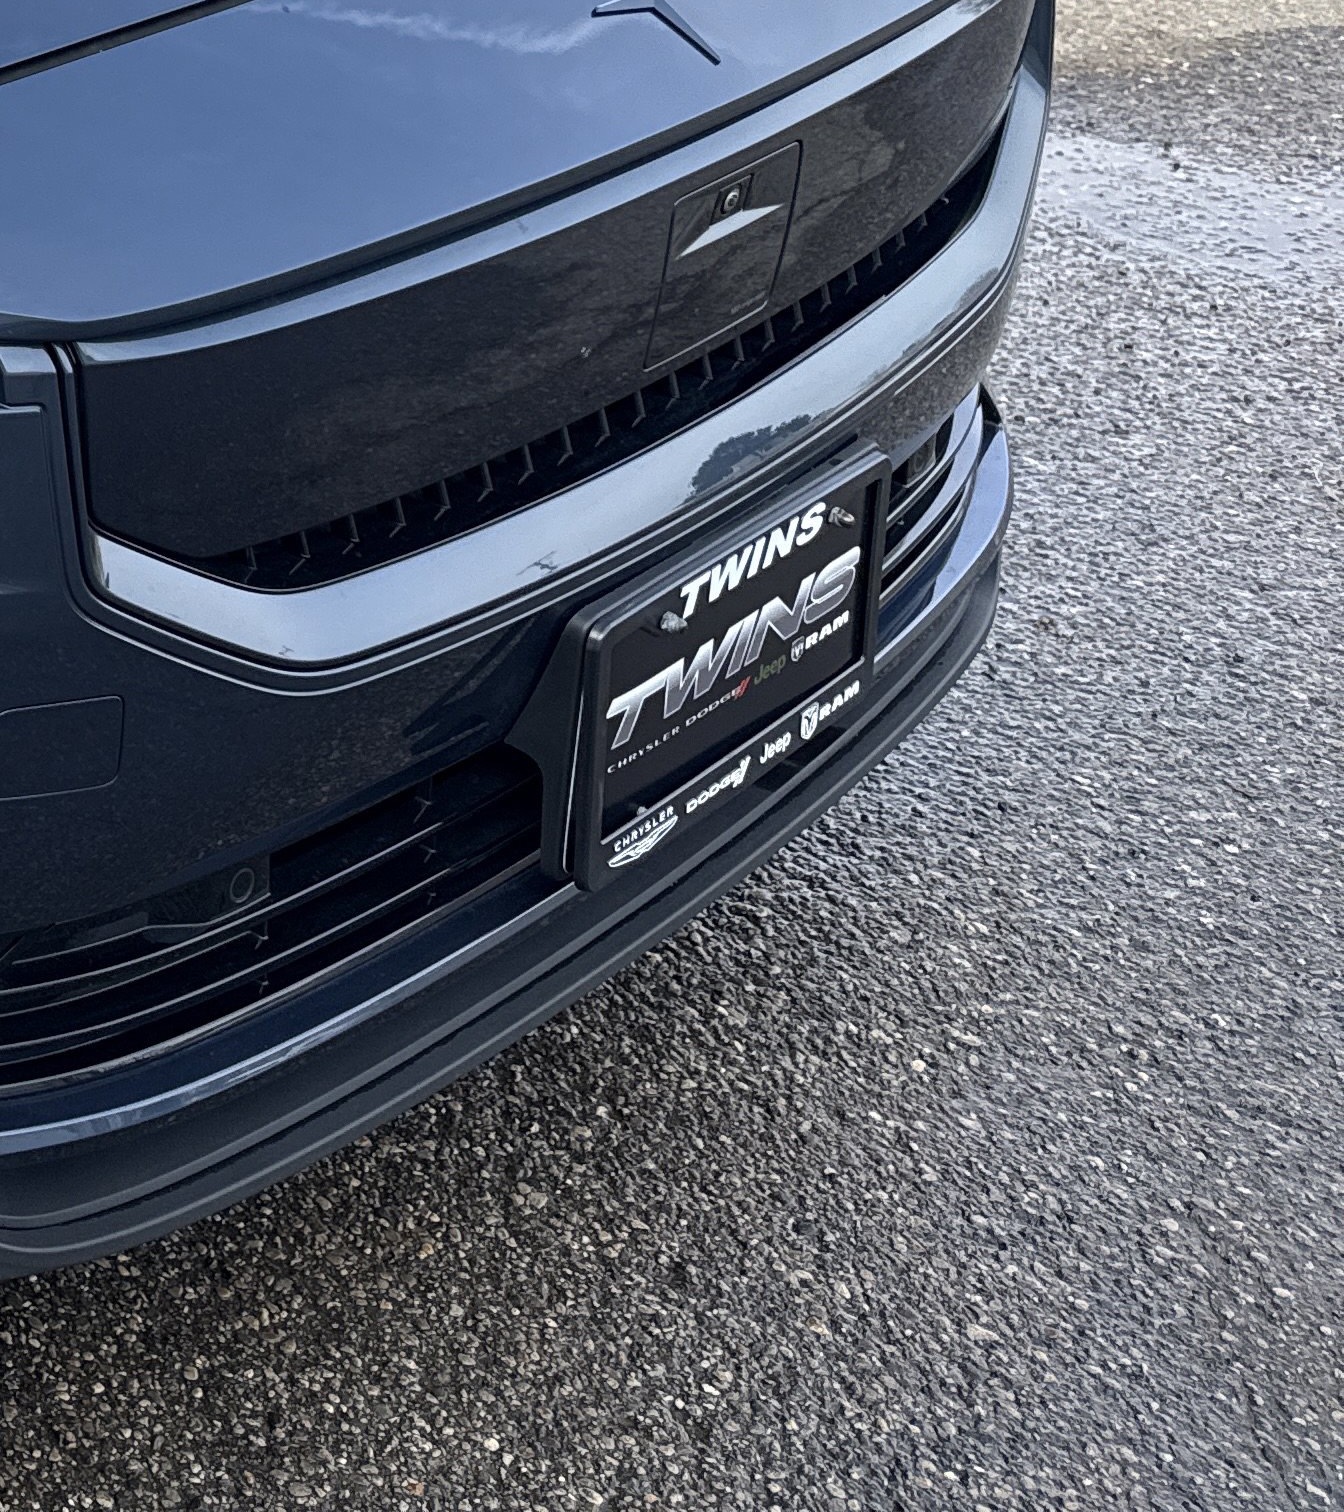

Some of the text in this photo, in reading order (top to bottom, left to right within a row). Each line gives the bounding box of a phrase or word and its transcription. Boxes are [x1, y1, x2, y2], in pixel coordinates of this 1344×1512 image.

[680, 502, 826, 619] TWINS
[606, 546, 861, 750] TWINS
[607, 725, 680, 773] CHRYSLER
[754, 654, 787, 685] Jeep
[805, 610, 849, 650] RAM
[613, 806, 675, 852] CHRYSLER
[760, 732, 792, 764] Jeep
[819, 680, 860, 721] RAM
